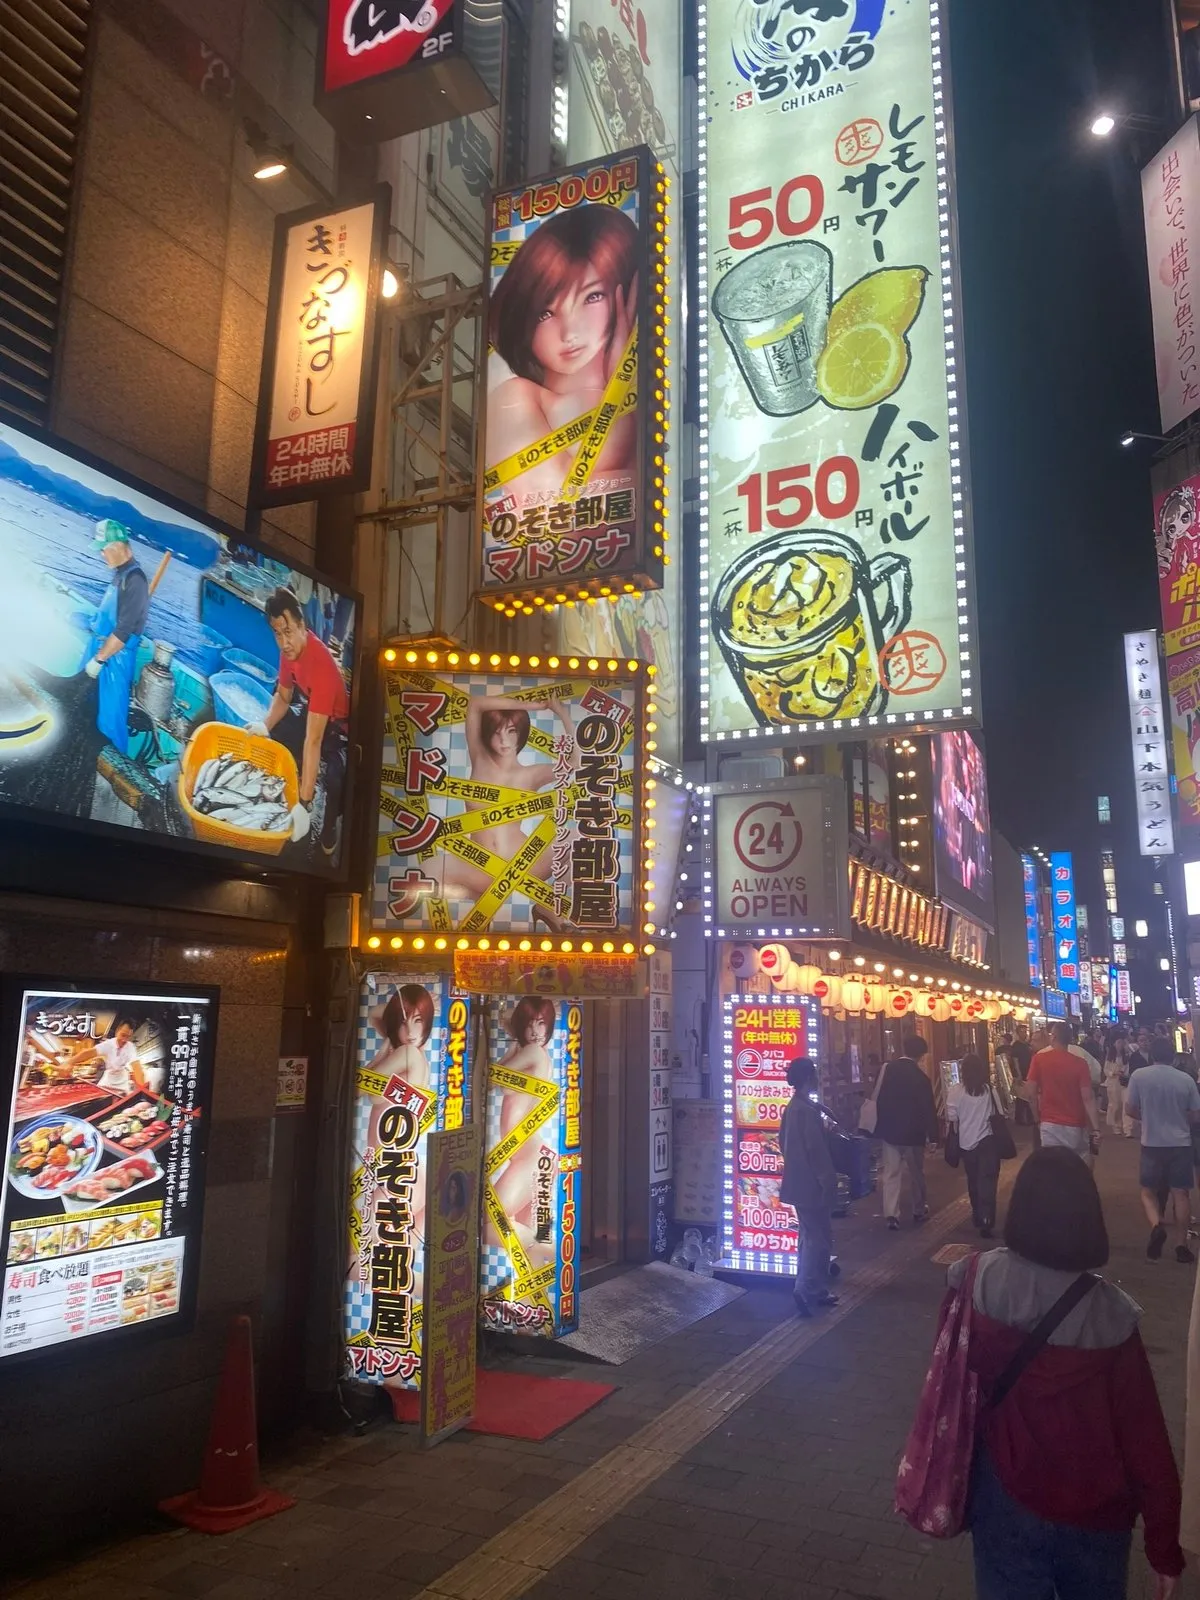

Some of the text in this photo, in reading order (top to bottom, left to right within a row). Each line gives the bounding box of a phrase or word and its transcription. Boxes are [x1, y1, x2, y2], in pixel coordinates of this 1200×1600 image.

[423, 32, 452, 58] 2F
[753, 34, 875, 101] ちから
[781, 83, 844, 112] CHIKARA
[513, 158, 638, 221] 1500円
[299, 225, 352, 416] きづなすし
[276, 427, 349, 462] 24時間
[268, 452, 352, 487] 年中無休
[491, 489, 636, 543] のぞき部屋
[489, 530, 631, 583] マドンナ
[390, 691, 446, 920] マドンナ
[551, 734, 574, 917] 素人ストリップショー
[574, 713, 622, 928] のぞき部屋
[748, 821, 784, 855] 24
[731, 894, 808, 918] OPEN
[732, 876, 807, 893] ALWAYS
[735, 1008, 802, 1029] 24H営業
[741, 1031, 797, 1045] (年中無休)
[387, 1083, 425, 1116] 元祖
[566, 1006, 582, 1149] のぞき部屋
[439, 1130, 475, 1152] PEEP
[371, 1104, 420, 1348] のぞき部屋
[560, 1172, 576, 1318] 1500円
